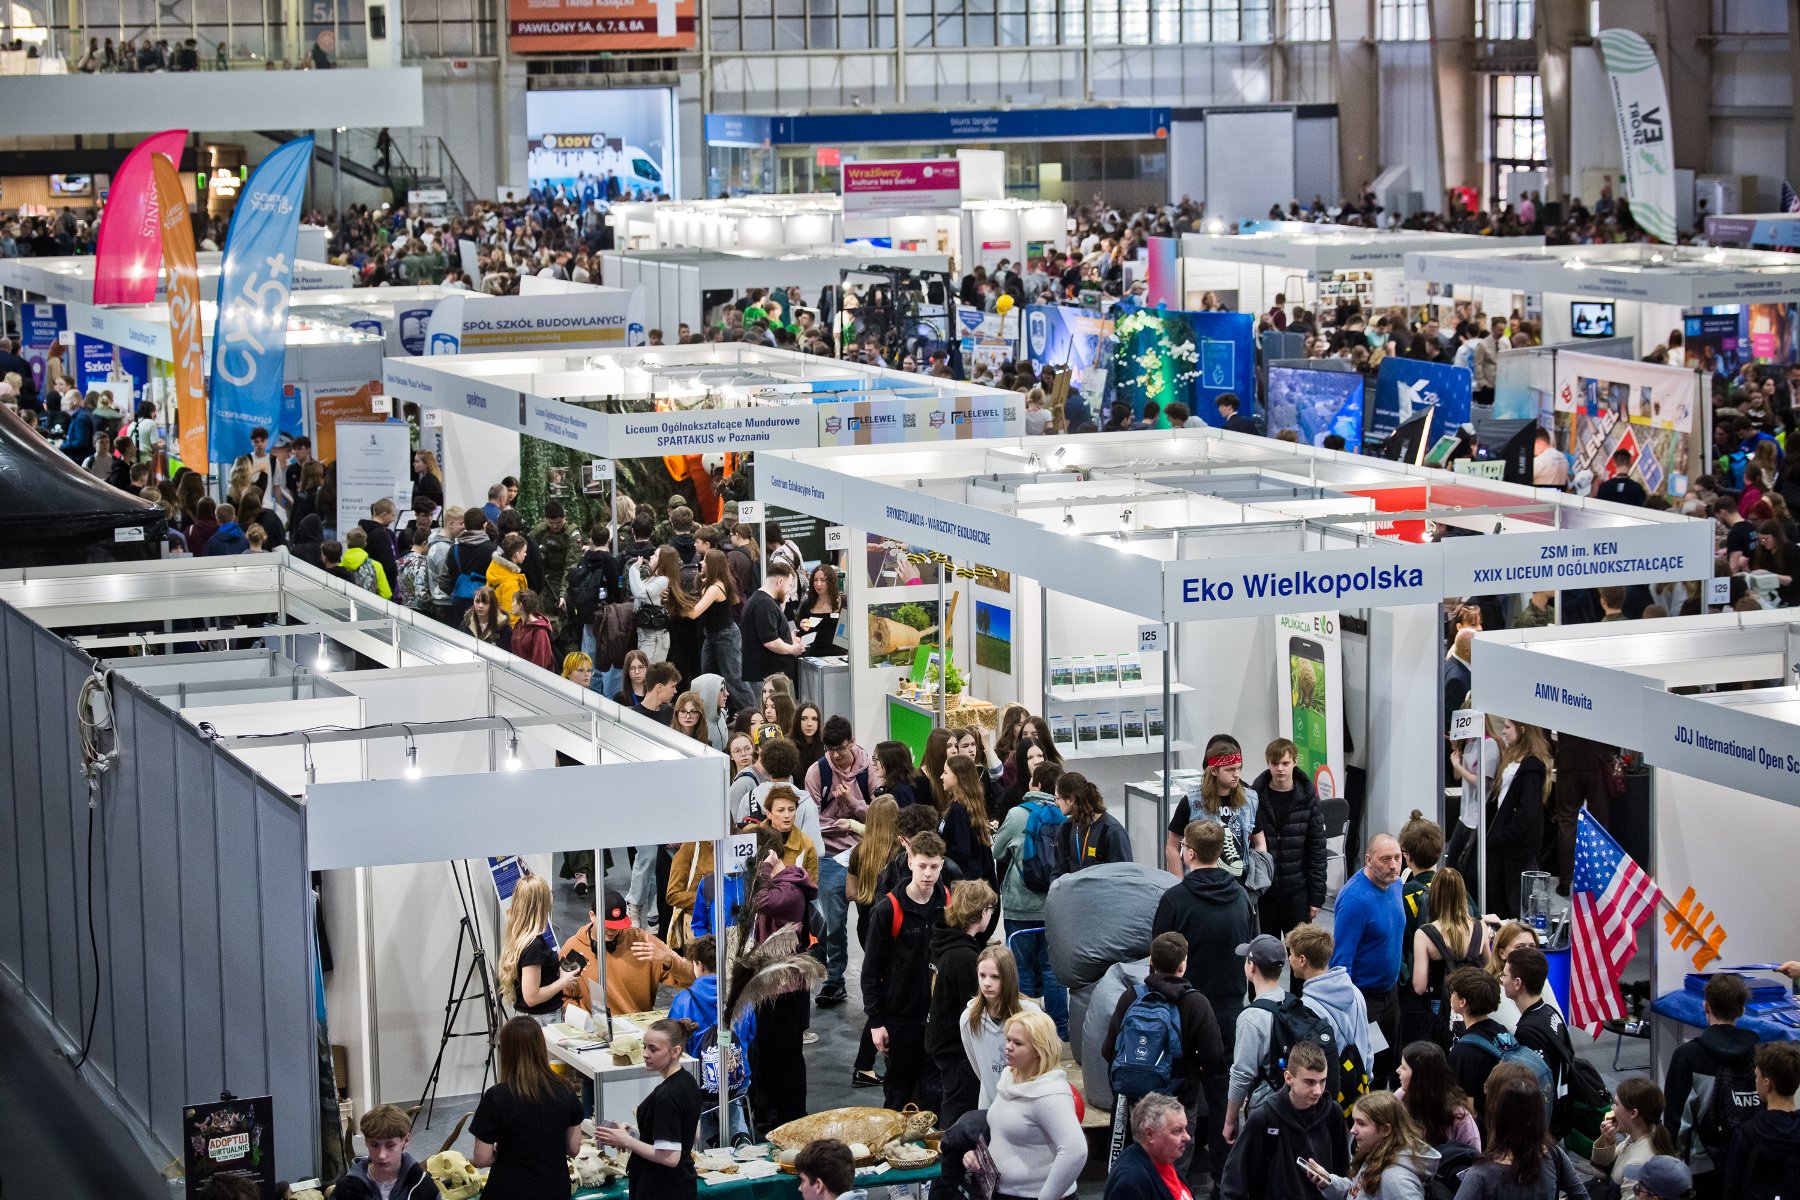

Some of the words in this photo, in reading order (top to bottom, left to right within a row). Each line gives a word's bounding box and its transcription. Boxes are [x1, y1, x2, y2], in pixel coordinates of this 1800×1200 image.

[518, 22, 575, 34] PAWILONY
[557, 135, 591, 148] LODY
[462, 318, 492, 331] SPÓŁ
[496, 316, 534, 330] SZKÓŁ
[536, 314, 626, 329] BUDOWLANYCH
[860, 414, 896, 424] LELEWEL
[963, 409, 1000, 418] LELEWEL
[625, 422, 659, 435] Liceum
[661, 420, 742, 434] Ogólnokształcące
[745, 417, 800, 428] Mundurowe
[657, 433, 714, 447] SPARTAKUS
[717, 435, 726, 443] w
[729, 432, 770, 443] Poznaniu
[1572, 408, 1619, 472] ELEWEL
[594, 464, 606, 472] 150
[771, 475, 788, 490] Centrum
[788, 479, 811, 497] Edukacyjne
[811, 485, 825, 500] Futura
[741, 507, 753, 516] 127
[886, 506, 924, 528] BRYKIETOLANDIA
[928, 517, 957, 536] WARSZTATY
[957, 525, 991, 546] EKOLOGICZNE
[828, 532, 841, 542] 126
[1541, 546, 1568, 560] ZSM
[1571, 544, 1589, 557] im.
[1593, 542, 1618, 556] KEN
[1474, 568, 1502, 583] XXIX
[1506, 565, 1553, 580] LICEUM
[1557, 555, 1684, 577] OGÓLNOKSZTAŁCĄCE
[1183, 577, 1234, 603] Eko
[1242, 564, 1424, 599] Wielkopolska
[1714, 584, 1728, 594] 129
[1280, 616, 1311, 633] APLIKACJA
[1141, 630, 1157, 642] 125
[1535, 682, 1560, 703] AMW
[1562, 688, 1592, 710] Rewita
[1455, 716, 1472, 728] 120
[1674, 725, 1693, 745] JDJ
[1696, 730, 1756, 762] International
[1758, 748, 1784, 770] Open
[1787, 755, 1800, 774] Sc
[734, 843, 754, 857] 123
[1731, 1089, 1761, 1107] VANS
[210, 1134, 248, 1150] ADOPTUJ
[210, 1144, 249, 1158] WIRTUALNIE
